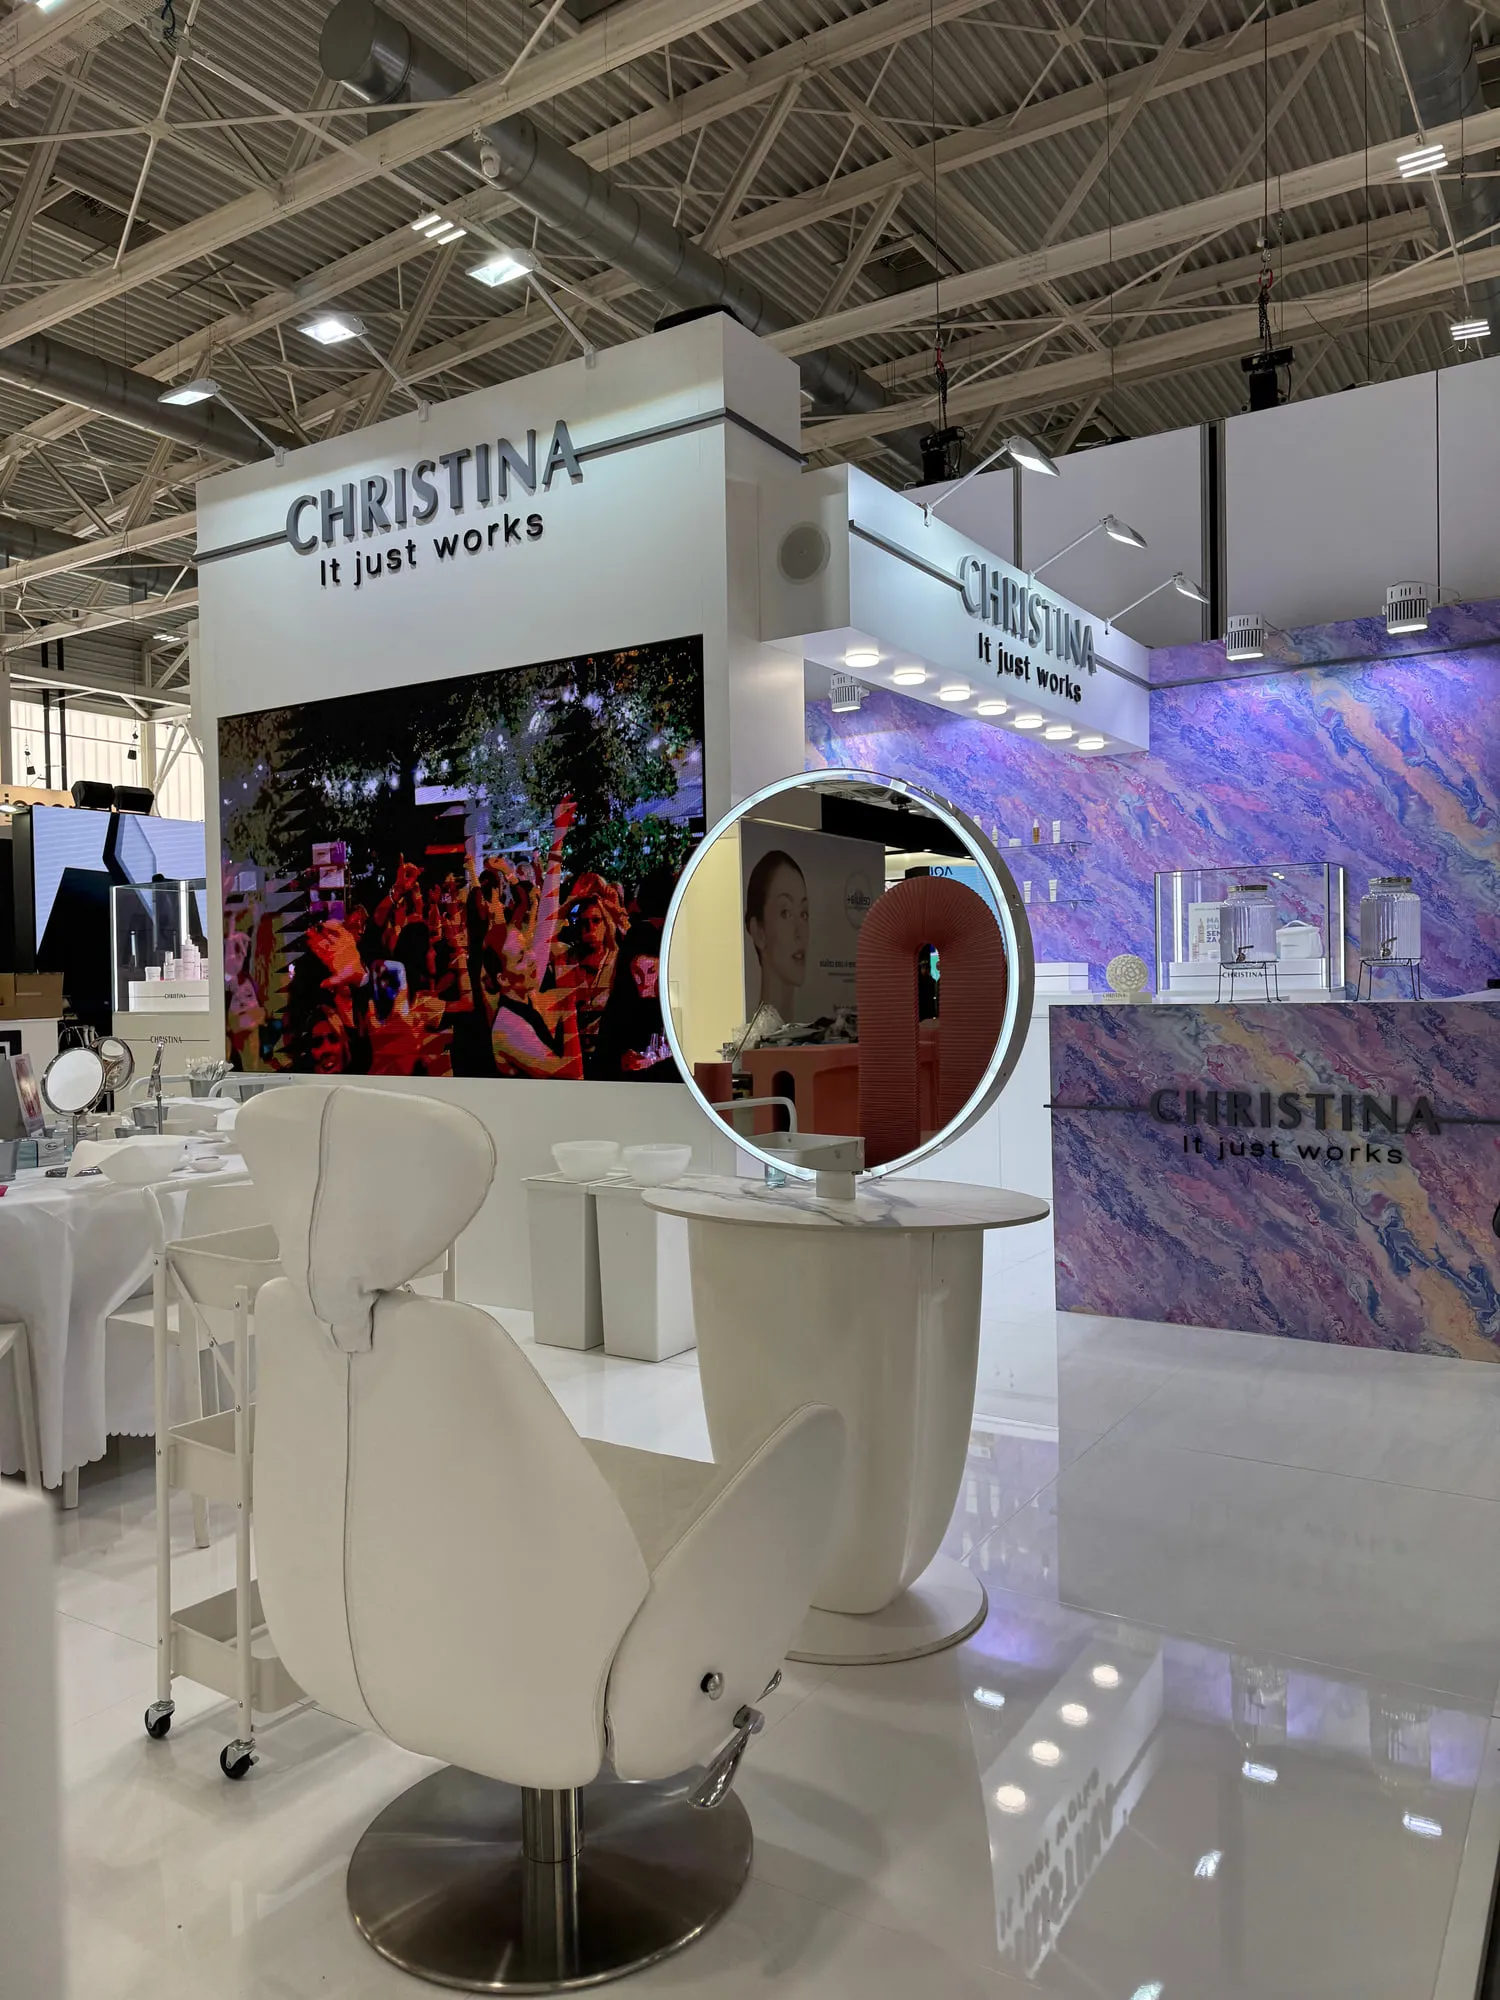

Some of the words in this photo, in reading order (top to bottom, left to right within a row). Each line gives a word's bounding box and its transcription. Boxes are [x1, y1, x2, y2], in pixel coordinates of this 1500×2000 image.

[286, 419, 584, 553] CHRISTINA
[320, 556, 342, 586] It
[353, 537, 418, 587] just
[433, 512, 544, 559] works
[957, 555, 1097, 676] CHRISTINA
[978, 632, 992, 663] It
[997, 642, 1031, 680] just
[1036, 666, 1082, 703] works
[1222, 971, 1263, 979] CHRISTINA
[150, 1035, 183, 1044] CHRISTINA
[1150, 1088, 1441, 1136] CHRISTINA
[1183, 1135, 1203, 1154] It
[1216, 1138, 1280, 1161] just
[1297, 1143, 1403, 1165] works
